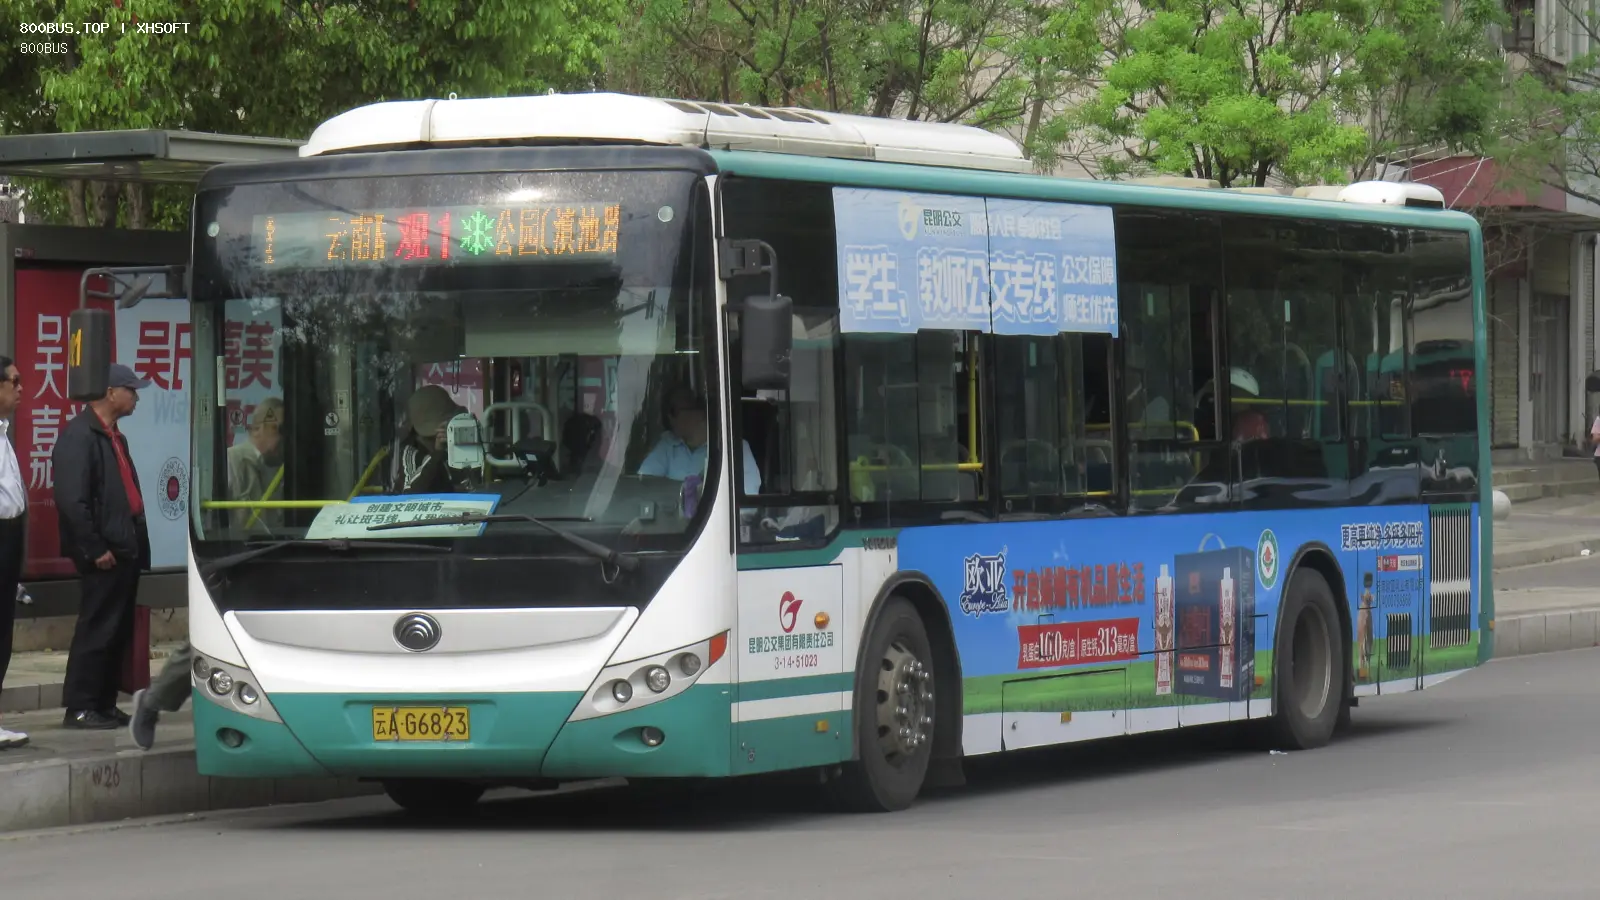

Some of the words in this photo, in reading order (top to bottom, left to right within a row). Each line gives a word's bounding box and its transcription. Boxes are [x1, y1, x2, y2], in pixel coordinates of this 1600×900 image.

[923, 208, 963, 228] 昆明公交
[1062, 255, 1115, 285] 公交保障
[1063, 293, 1116, 325] 师生优先
[366, 501, 444, 513] 创建文明城市
[965, 556, 1005, 595] 欧亚
[749, 631, 834, 654] 昆明公交集团有限责任公司
[92, 761, 120, 788] W26
